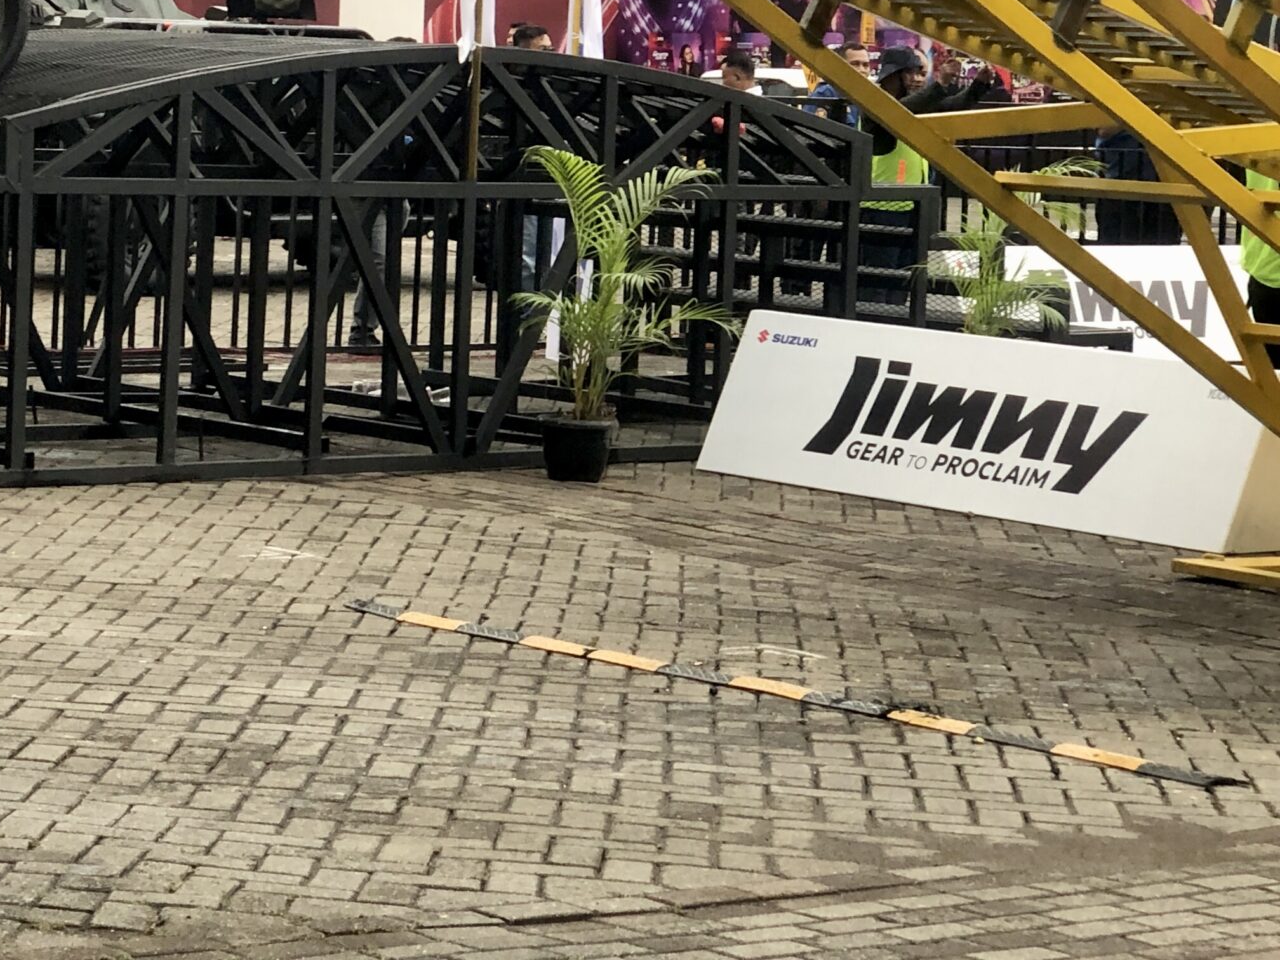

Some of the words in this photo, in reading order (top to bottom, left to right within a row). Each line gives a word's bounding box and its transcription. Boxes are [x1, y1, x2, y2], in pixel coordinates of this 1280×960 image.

[772, 333, 819, 348] SUZUKI
[803, 355, 1149, 495] Jimny
[845, 440, 904, 466] GEAR
[906, 453, 928, 470] TO
[931, 453, 1051, 489] PROCLAIM
